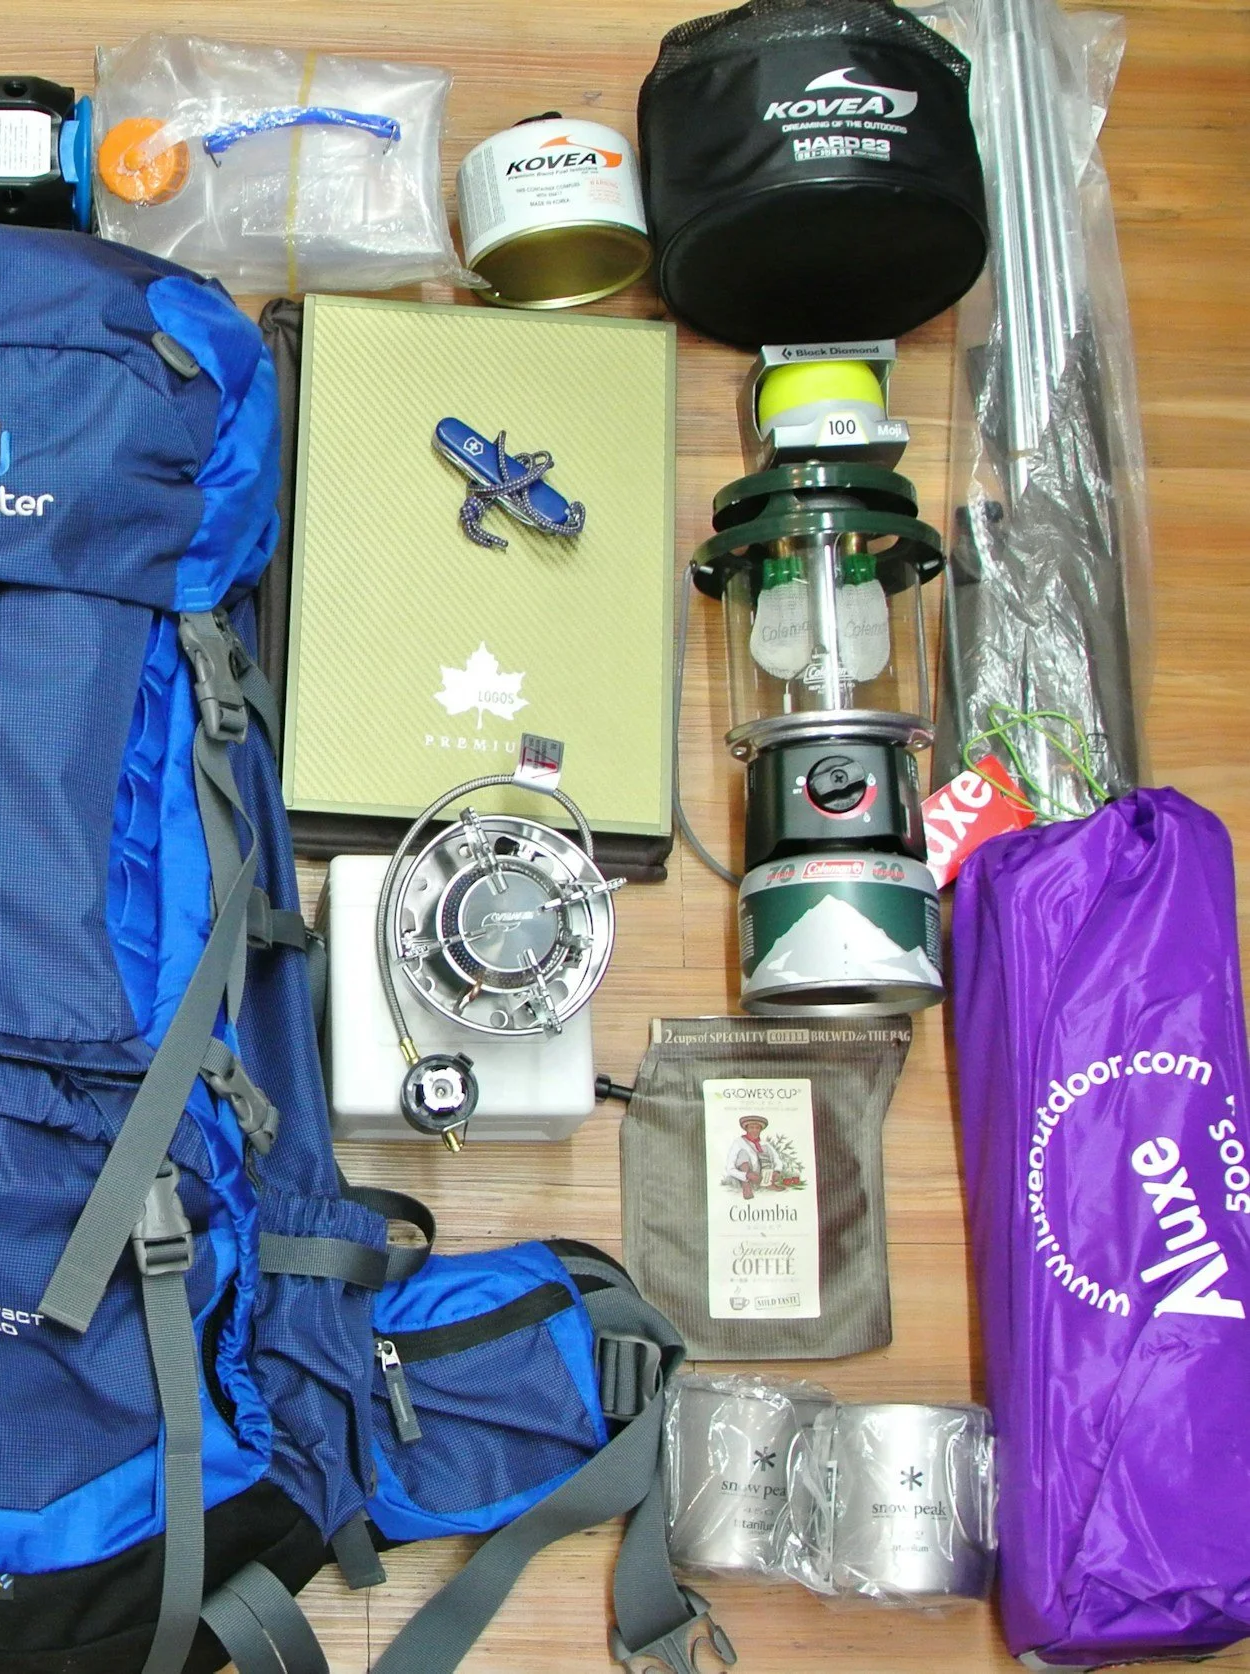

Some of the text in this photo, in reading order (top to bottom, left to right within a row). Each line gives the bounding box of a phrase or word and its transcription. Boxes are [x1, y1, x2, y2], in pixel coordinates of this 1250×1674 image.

[763, 96, 884, 121] KOVEA
[782, 120, 907, 134] DREAMING OF THE OUTDOORS
[794, 135, 890, 152] HARD 23
[506, 153, 597, 176] KOVEA
[796, 346, 879, 357] Black Diamond
[829, 420, 855, 435] 100
[878, 425, 901, 437] Moji
[478, 691, 515, 704] LOGOS
[425, 734, 515, 753] PREMIU
[807, 862, 852, 875] Coleman
[665, 1029, 673, 1044] 2
[673, 1034, 697, 1045] cups
[698, 1031, 708, 1043] of
[709, 1032, 766, 1043] SPECIALTY
[811, 1031, 856, 1042] BREWED
[856, 1033, 866, 1041] in
[868, 1030, 889, 1042] THE
[890, 1031, 910, 1042] BAG
[723, 1089, 797, 1099] GROWER'S CUP
[1027, 1051, 1212, 1317] www.luxeoutdoor.com
[729, 1204, 797, 1221] Colombia
[733, 1241, 795, 1261] Specialty
[732, 1258, 796, 1275] COFFEE
[914, 1501, 946, 1520] peak
